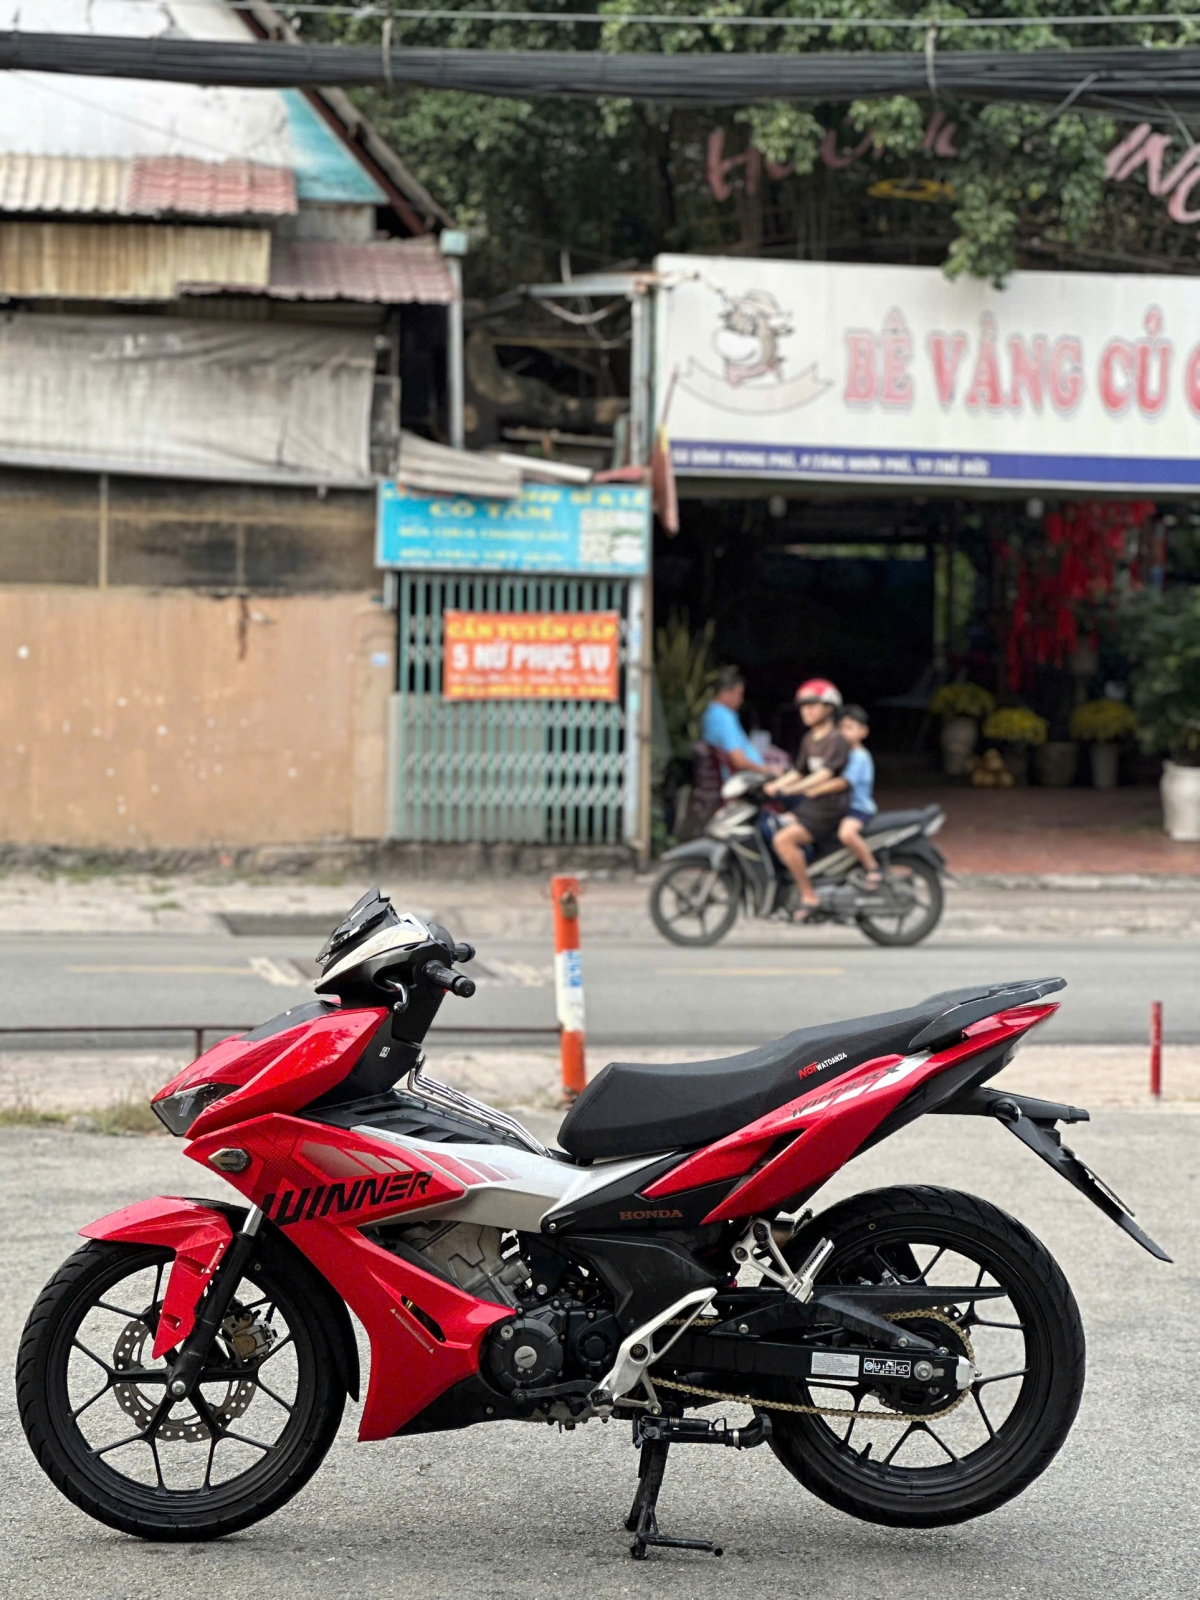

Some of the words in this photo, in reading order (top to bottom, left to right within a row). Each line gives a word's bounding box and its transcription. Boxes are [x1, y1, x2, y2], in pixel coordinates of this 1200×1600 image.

[844, 307, 914, 409] BÊ
[1100, 306, 1171, 415] CỦ
[511, 643, 574, 674] PHỤC
[260, 1170, 434, 1227] WINNER
[619, 1209, 684, 1220] HONDA
